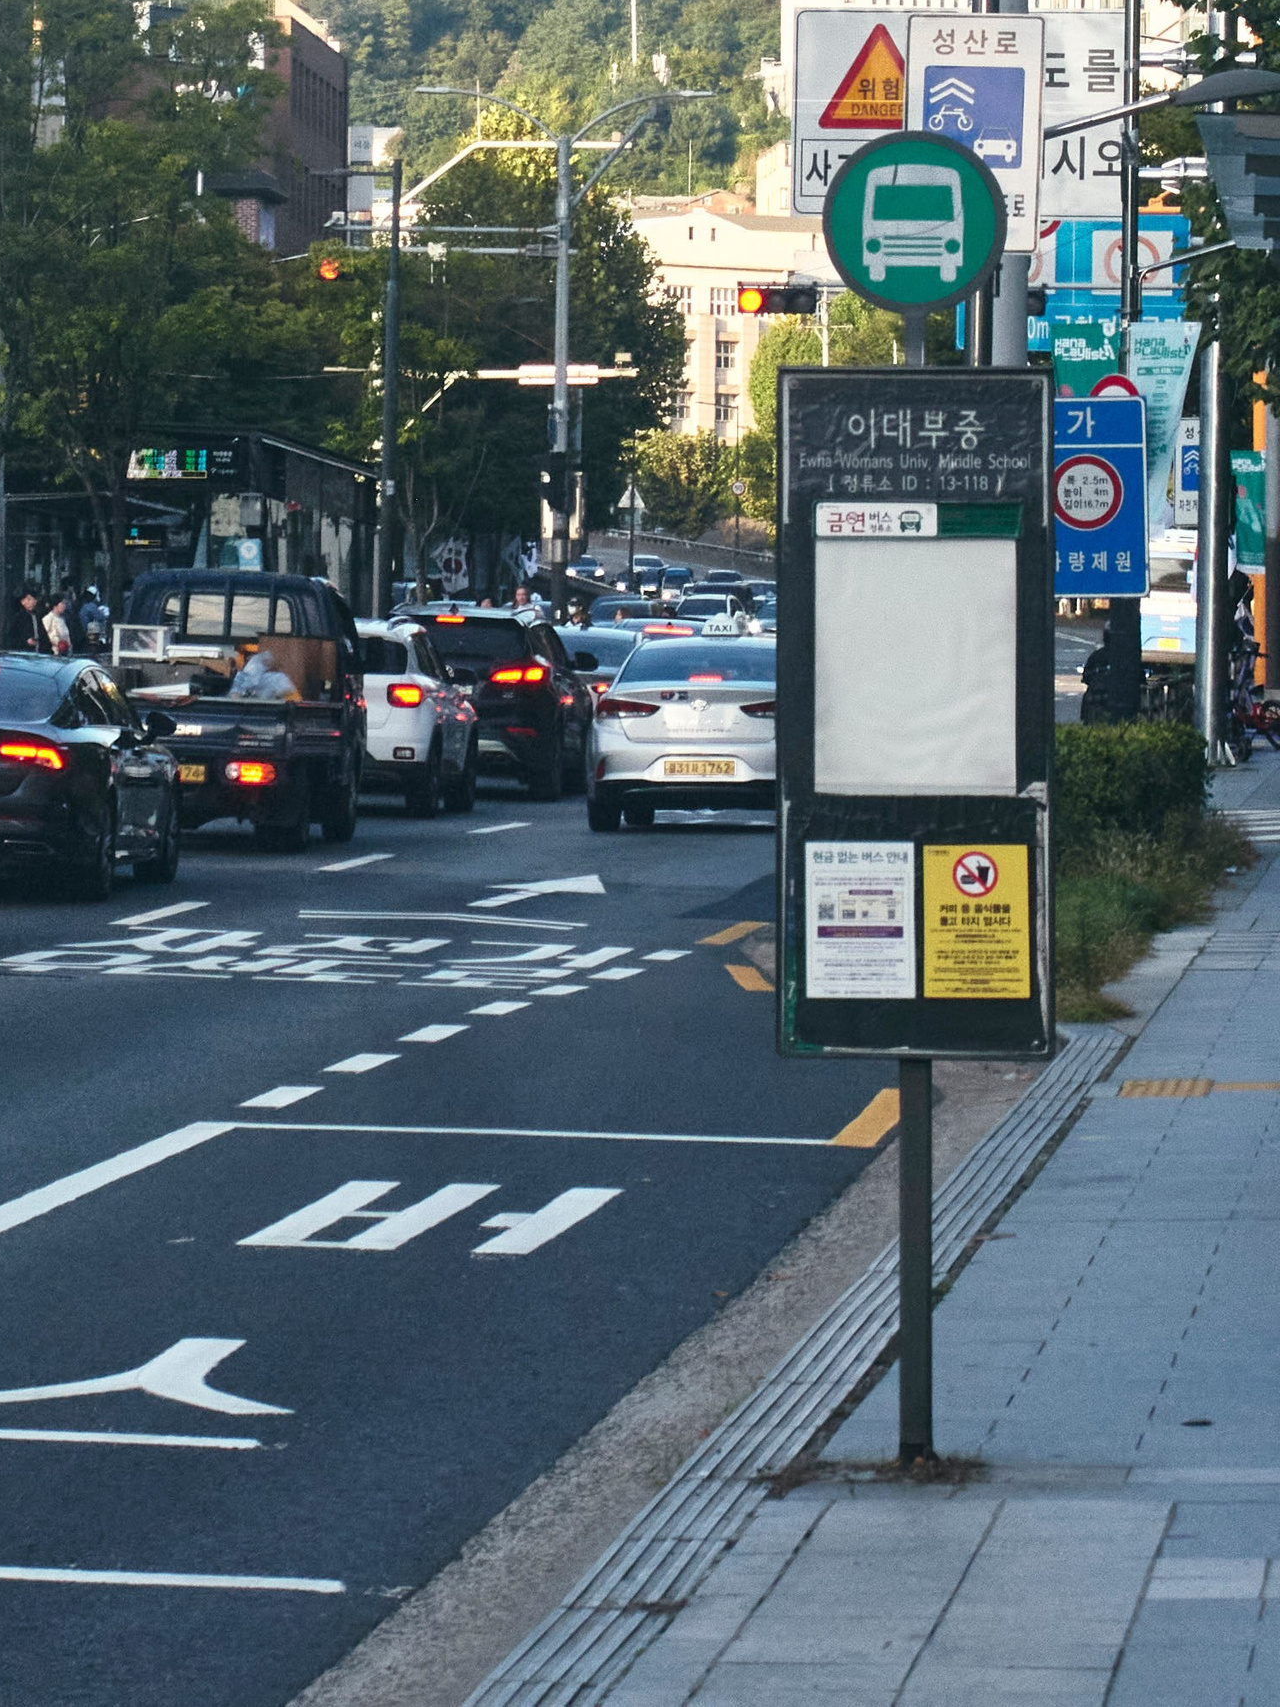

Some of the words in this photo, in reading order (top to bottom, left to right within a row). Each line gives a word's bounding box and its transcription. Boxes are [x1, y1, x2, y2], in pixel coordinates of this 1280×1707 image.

[932, 28, 1019, 55] 성산로
[1045, 49, 1120, 93] 도를
[858, 77, 900, 101] 위험
[1042, 136, 1122, 181] 시오
[1027, 316, 1049, 339] 0m
[848, 408, 985, 450] 이대부중
[1055, 406, 1096, 438] 가
[839, 454, 893, 469] Womans
[939, 453, 982, 469] Middle
[988, 453, 1031, 469] School
[939, 475, 989, 492] 13-118
[827, 512, 865, 533] 금연
[869, 511, 892, 523] 버스
[708, 624, 732, 632] TAXI
[57, 926, 635, 968] 자전거
